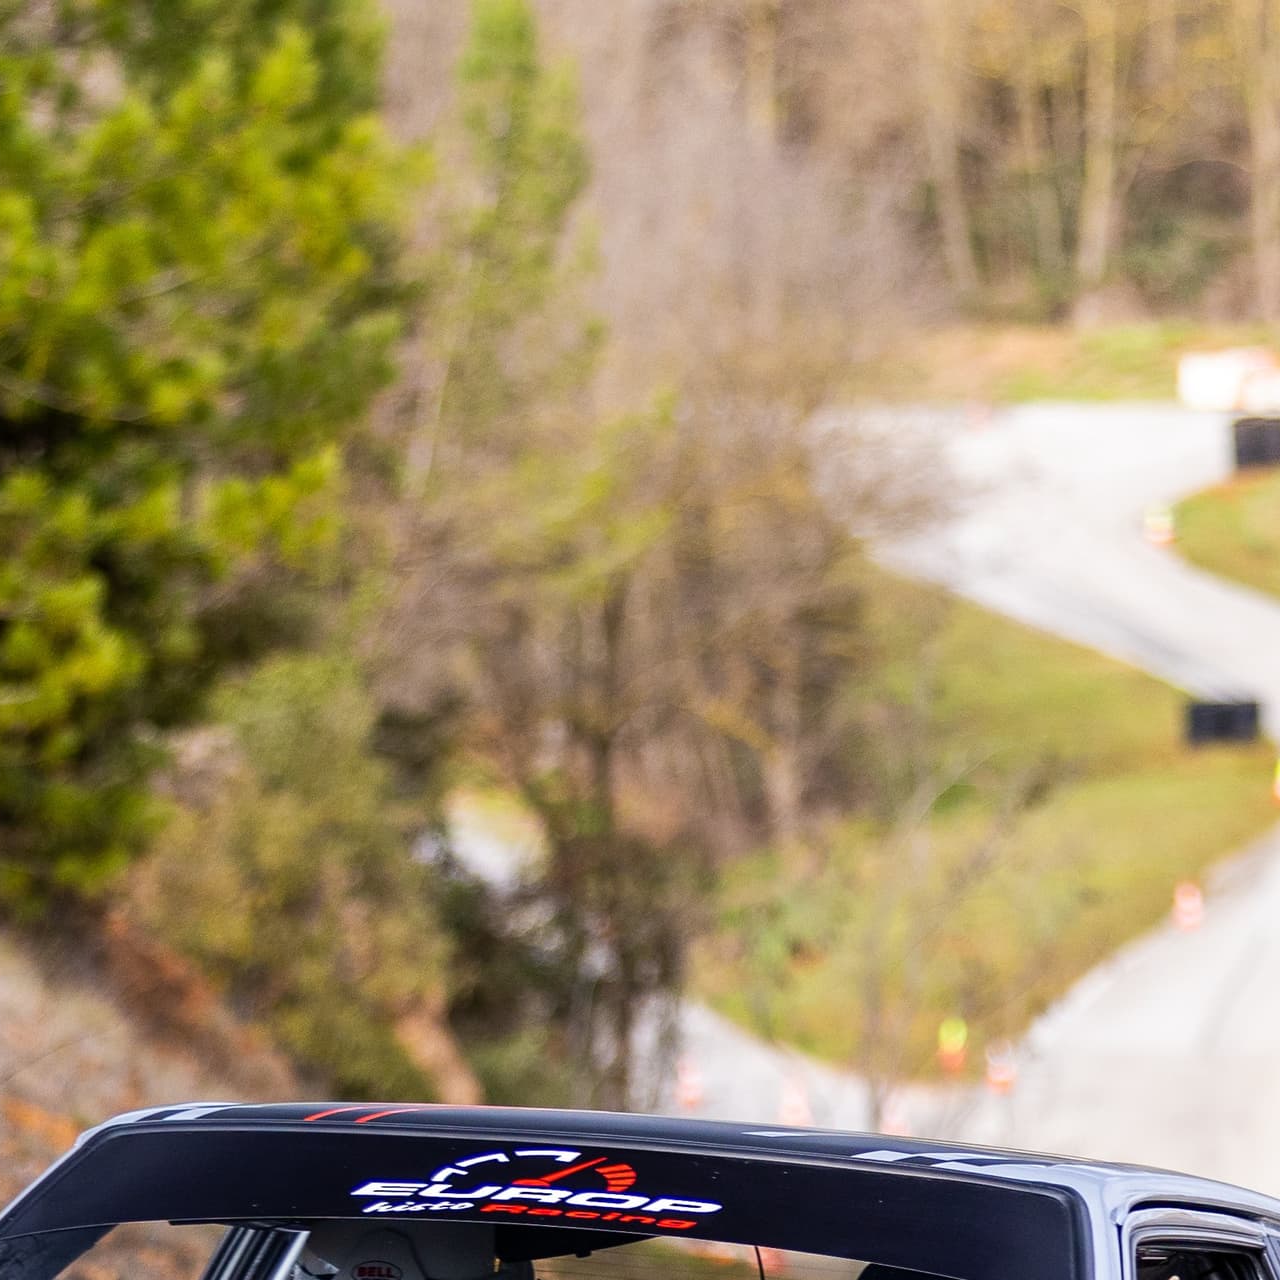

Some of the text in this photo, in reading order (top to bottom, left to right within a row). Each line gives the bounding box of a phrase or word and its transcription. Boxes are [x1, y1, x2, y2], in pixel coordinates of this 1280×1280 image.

[348, 1181, 724, 1215] EUROP
[362, 1200, 700, 1230] histo Racing
[356, 1266, 395, 1279] BELL
